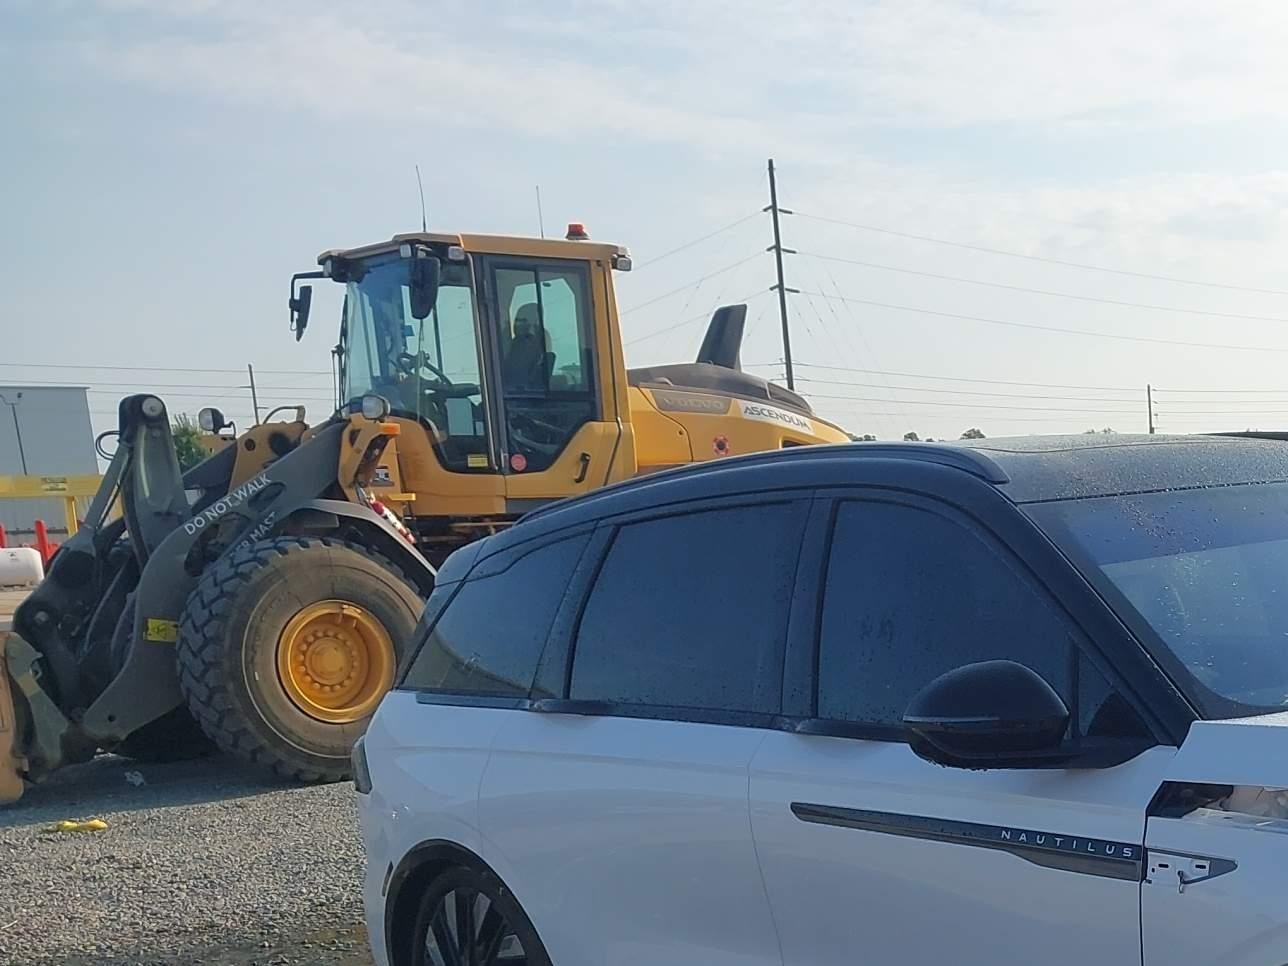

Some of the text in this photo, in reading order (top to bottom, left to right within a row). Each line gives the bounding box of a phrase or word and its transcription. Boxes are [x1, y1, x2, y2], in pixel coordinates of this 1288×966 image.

[743, 406, 811, 431] ASCENDUM
[183, 473, 272, 535] DO NOT WALK
[249, 511, 276, 542] MAST
[1001, 830, 1133, 858] NAUTILUS
